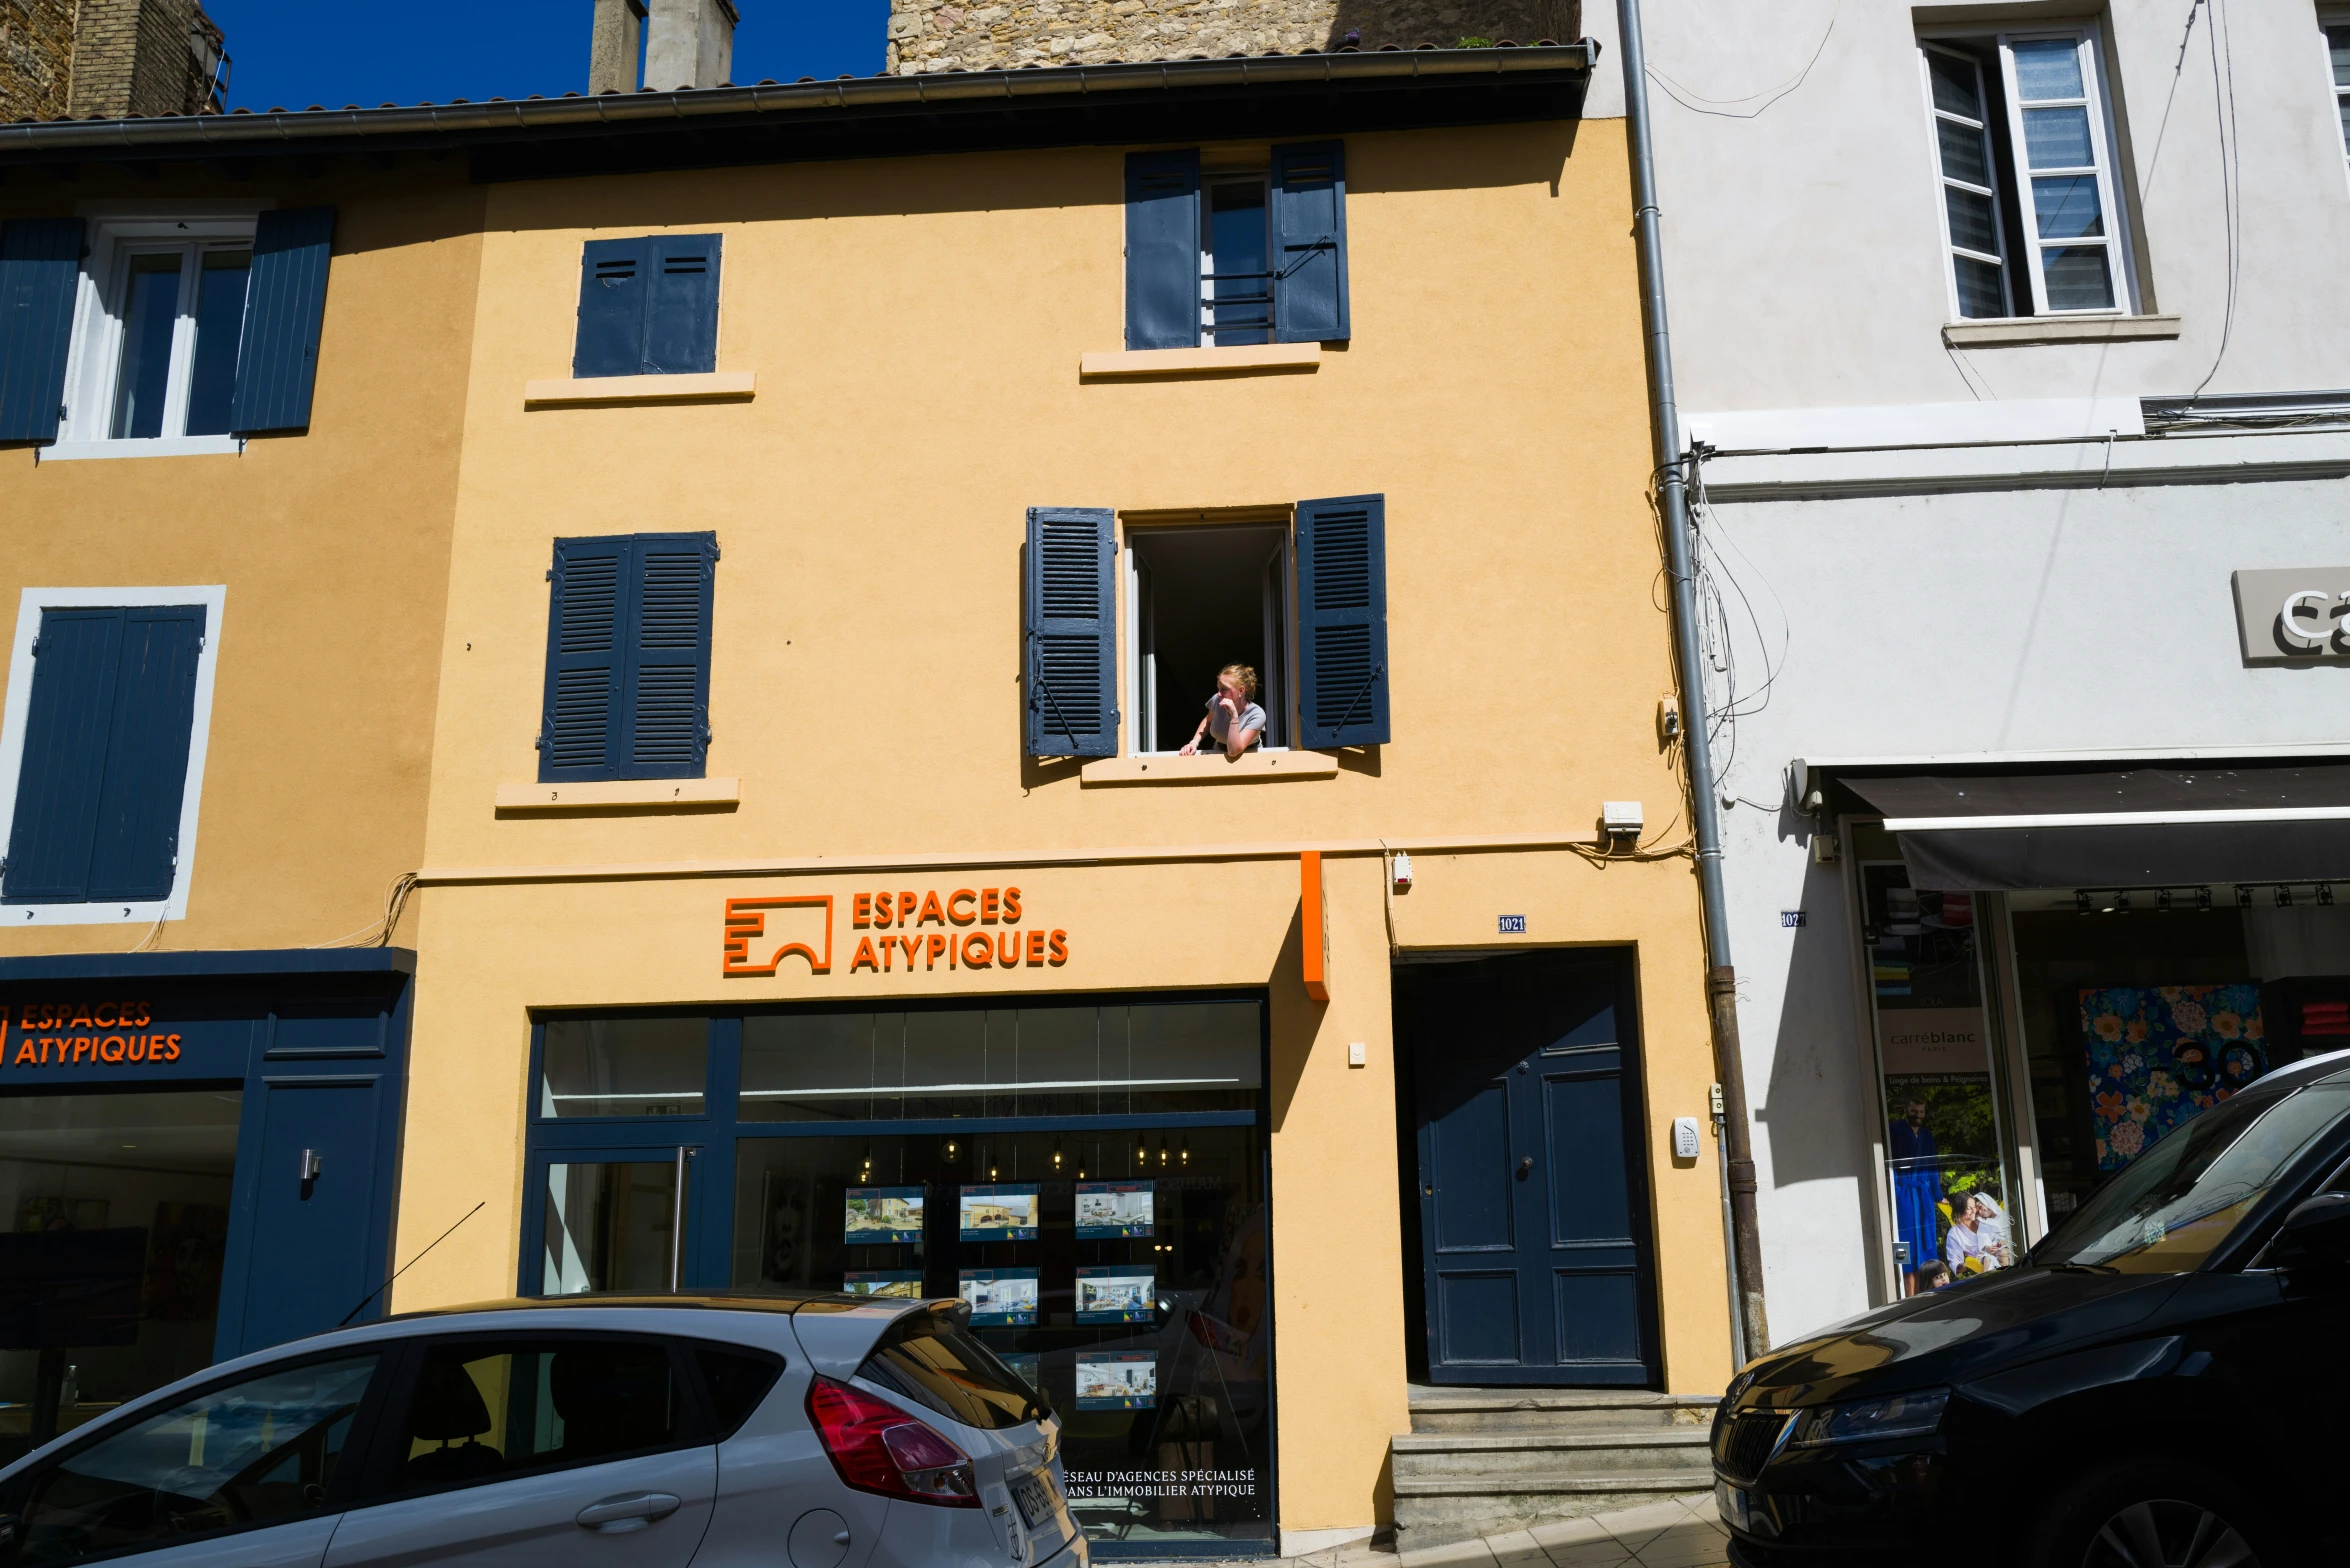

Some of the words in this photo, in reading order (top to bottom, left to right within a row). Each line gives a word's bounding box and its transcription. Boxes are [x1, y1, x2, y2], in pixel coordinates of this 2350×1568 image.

[852, 886, 1023, 926] ESPACES
[1500, 917, 1524, 931] 1021
[1781, 913, 1805, 927] 1027
[851, 929, 1069, 970] ATYPIQUES
[20, 1001, 152, 1031] ESPACES
[14, 1034, 182, 1065] ATYPIQUES
[1889, 1077, 1909, 1085] Linge
[1910, 1076, 1920, 1084] de
[1921, 1075, 1941, 1084] bains
[1943, 1075, 1949, 1083] &
[1950, 1075, 1988, 1085] Peignoires
[1063, 1469, 1103, 1483] ÉSEAU
[1180, 1467, 1255, 1481] SPÉCIALISÉ
[1191, 1484, 1255, 1497] ATYPIQUE
